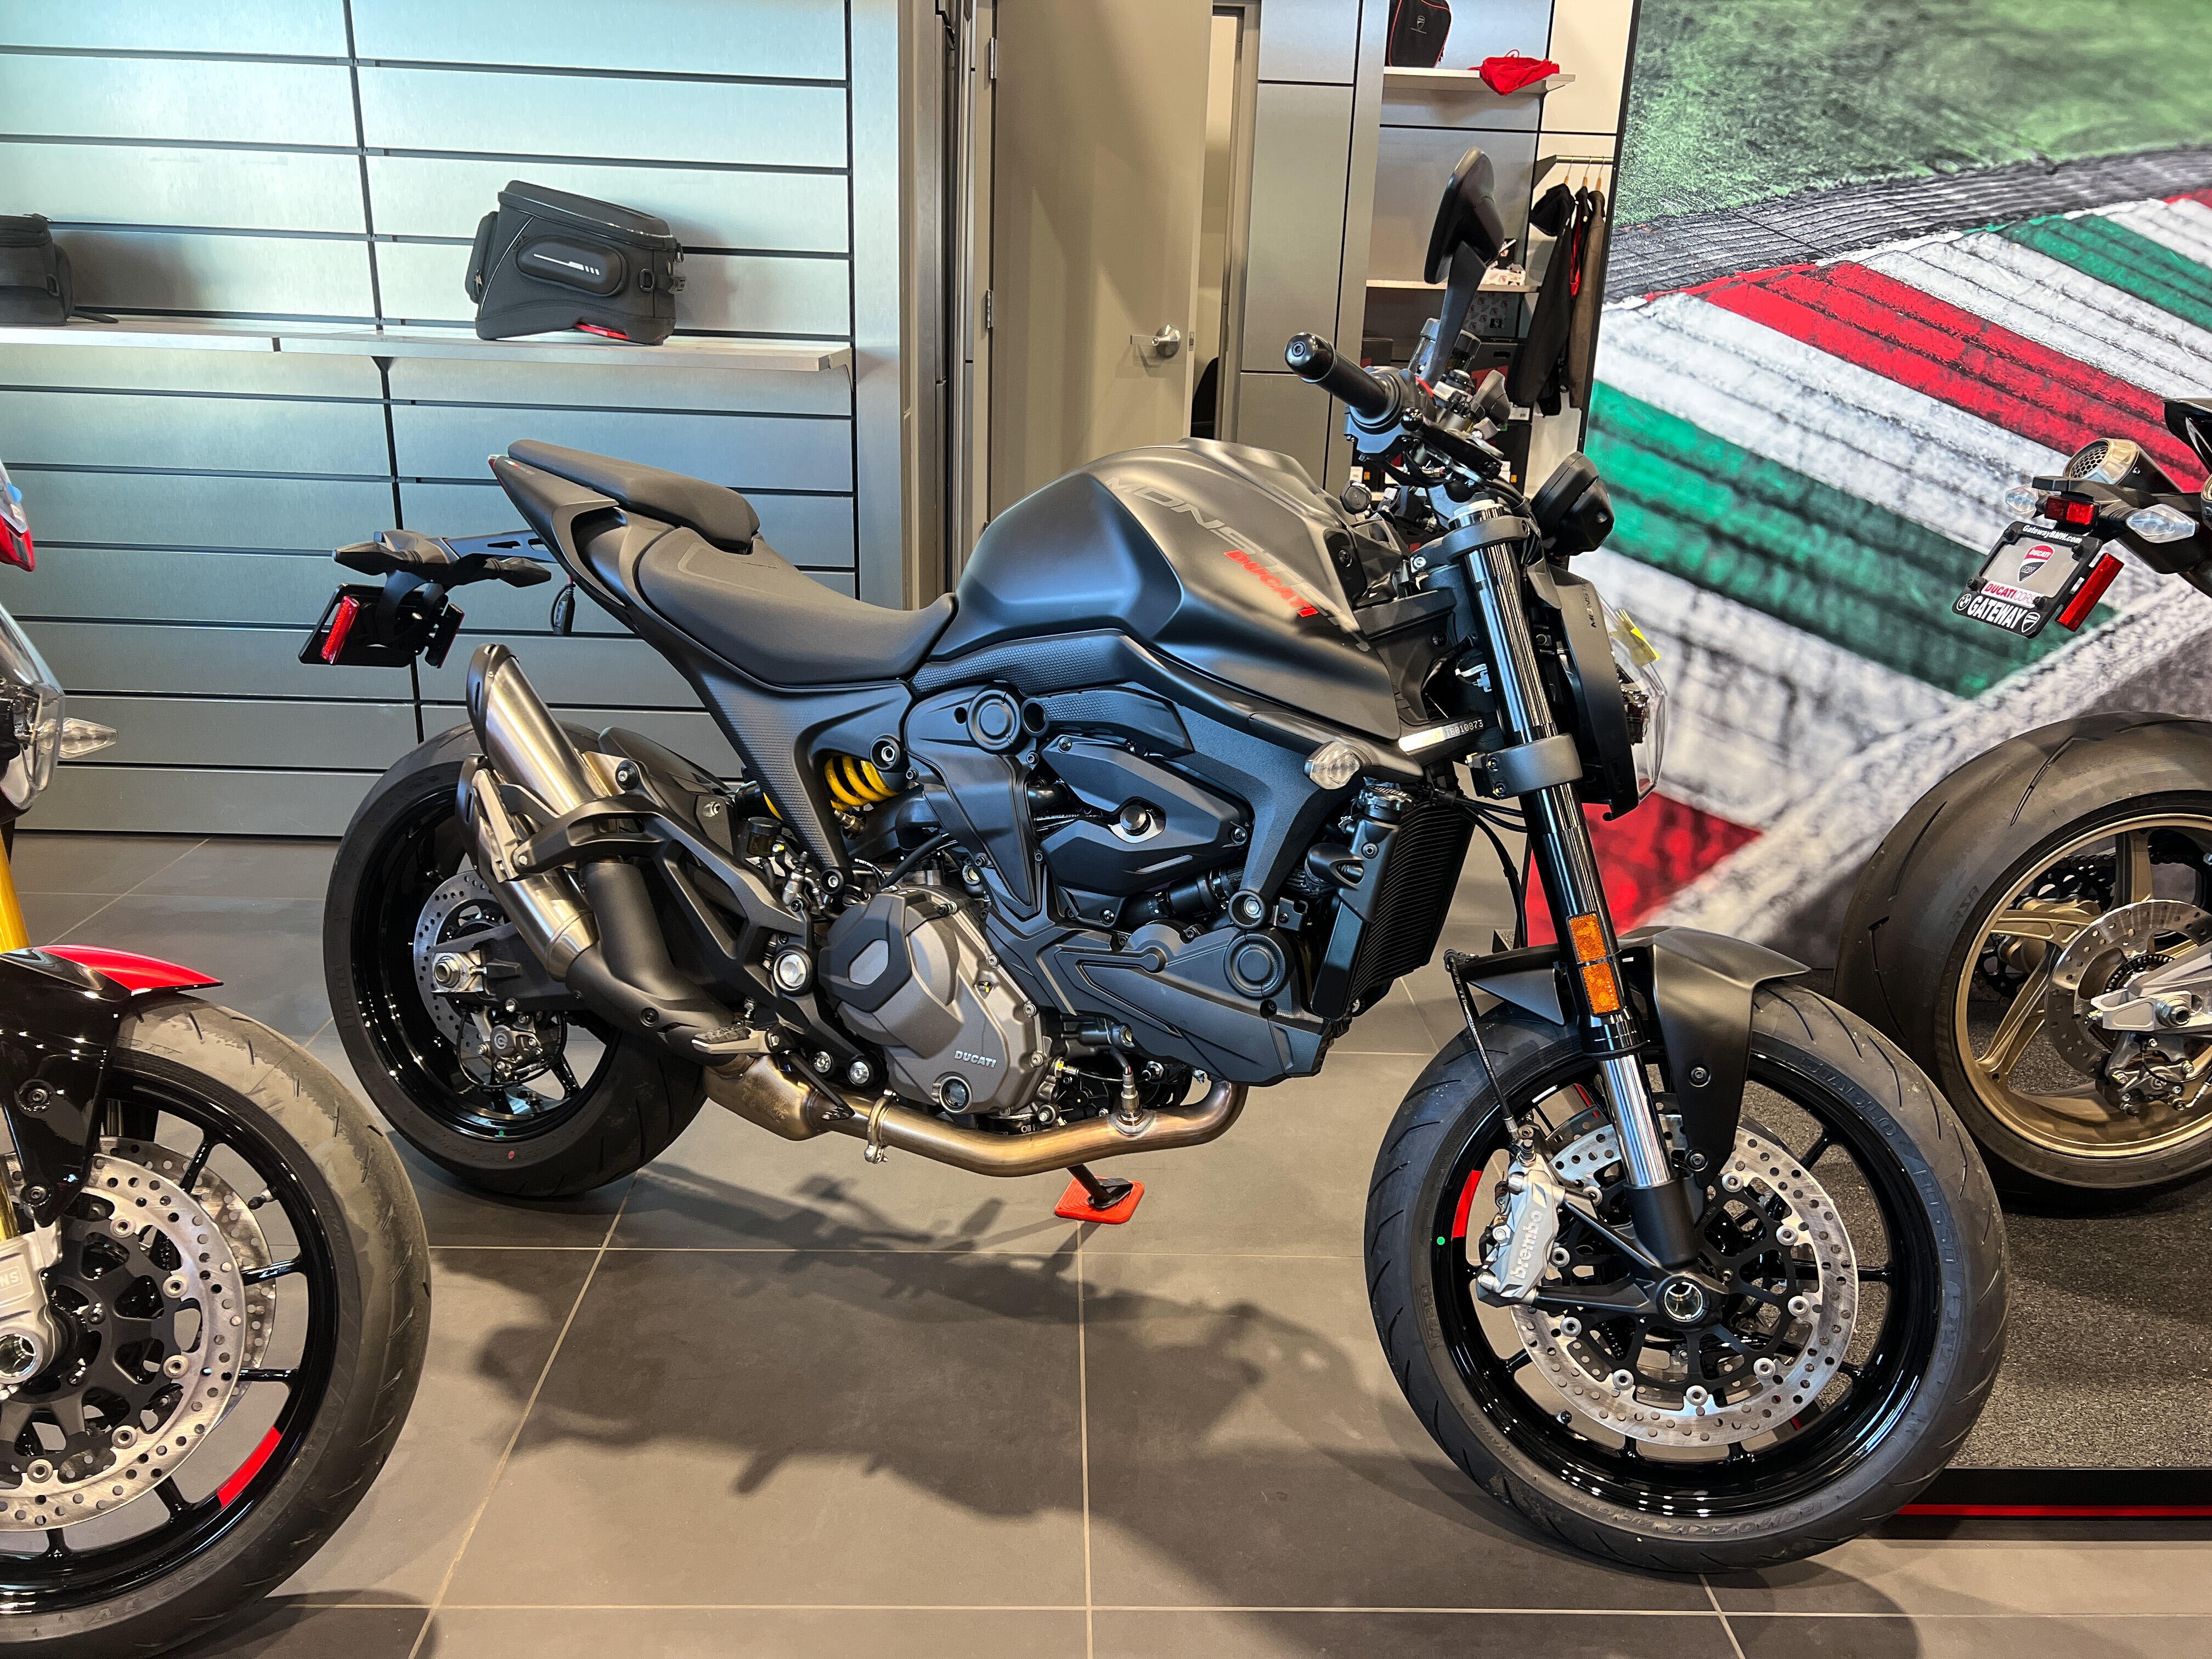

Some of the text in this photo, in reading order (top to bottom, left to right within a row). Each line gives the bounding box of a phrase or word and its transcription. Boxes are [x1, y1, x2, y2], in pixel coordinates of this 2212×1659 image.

[2022, 525, 2083, 544] GatewayBMW.com
[1103, 475, 1372, 652] MONSTER
[2029, 549, 2050, 558] DUCATI
[1223, 549, 1319, 618] DUCATI
[1967, 595, 2028, 629] GATEWAY
[954, 1050, 997, 1068] DUCATI
[1509, 1210, 1543, 1279] brembo
